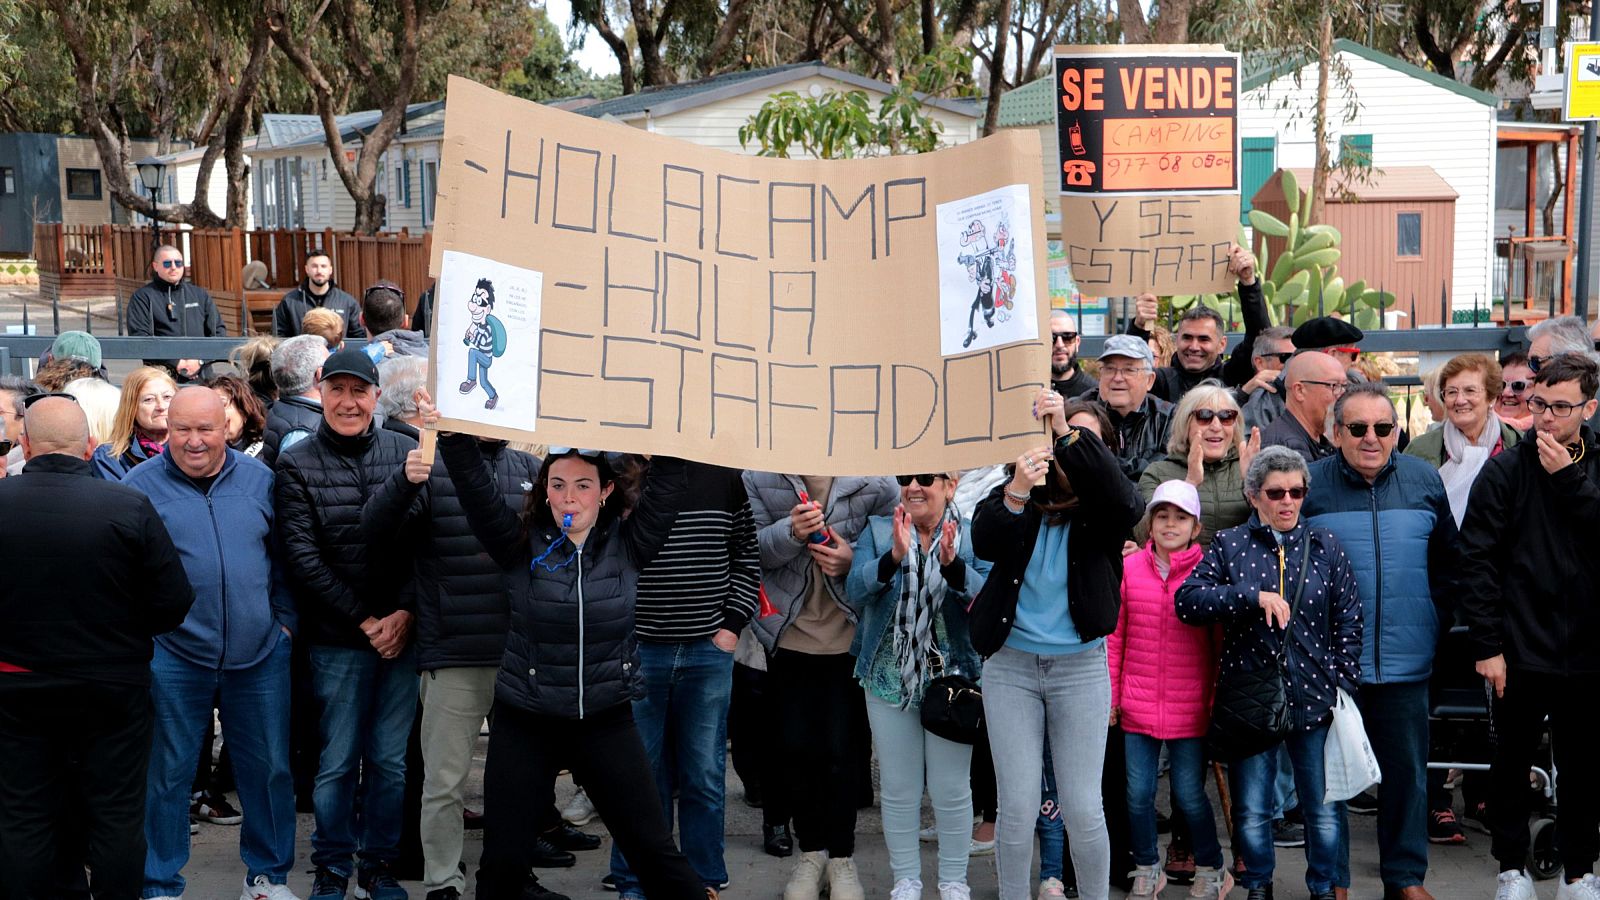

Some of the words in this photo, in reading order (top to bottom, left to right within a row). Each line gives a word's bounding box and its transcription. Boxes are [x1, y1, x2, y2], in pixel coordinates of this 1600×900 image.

[1062, 68, 1104, 111] SE
[1119, 67, 1233, 110] VENDE
[1112, 122, 1226, 146] CAMPING
[1107, 158, 1150, 178] 977
[1158, 153, 1182, 173] 68
[1091, 200, 1119, 243] Y
[1139, 199, 1201, 239] SE
[1069, 241, 1232, 287] ESTAFA
[537, 328, 1047, 457] ESTAFADOS
